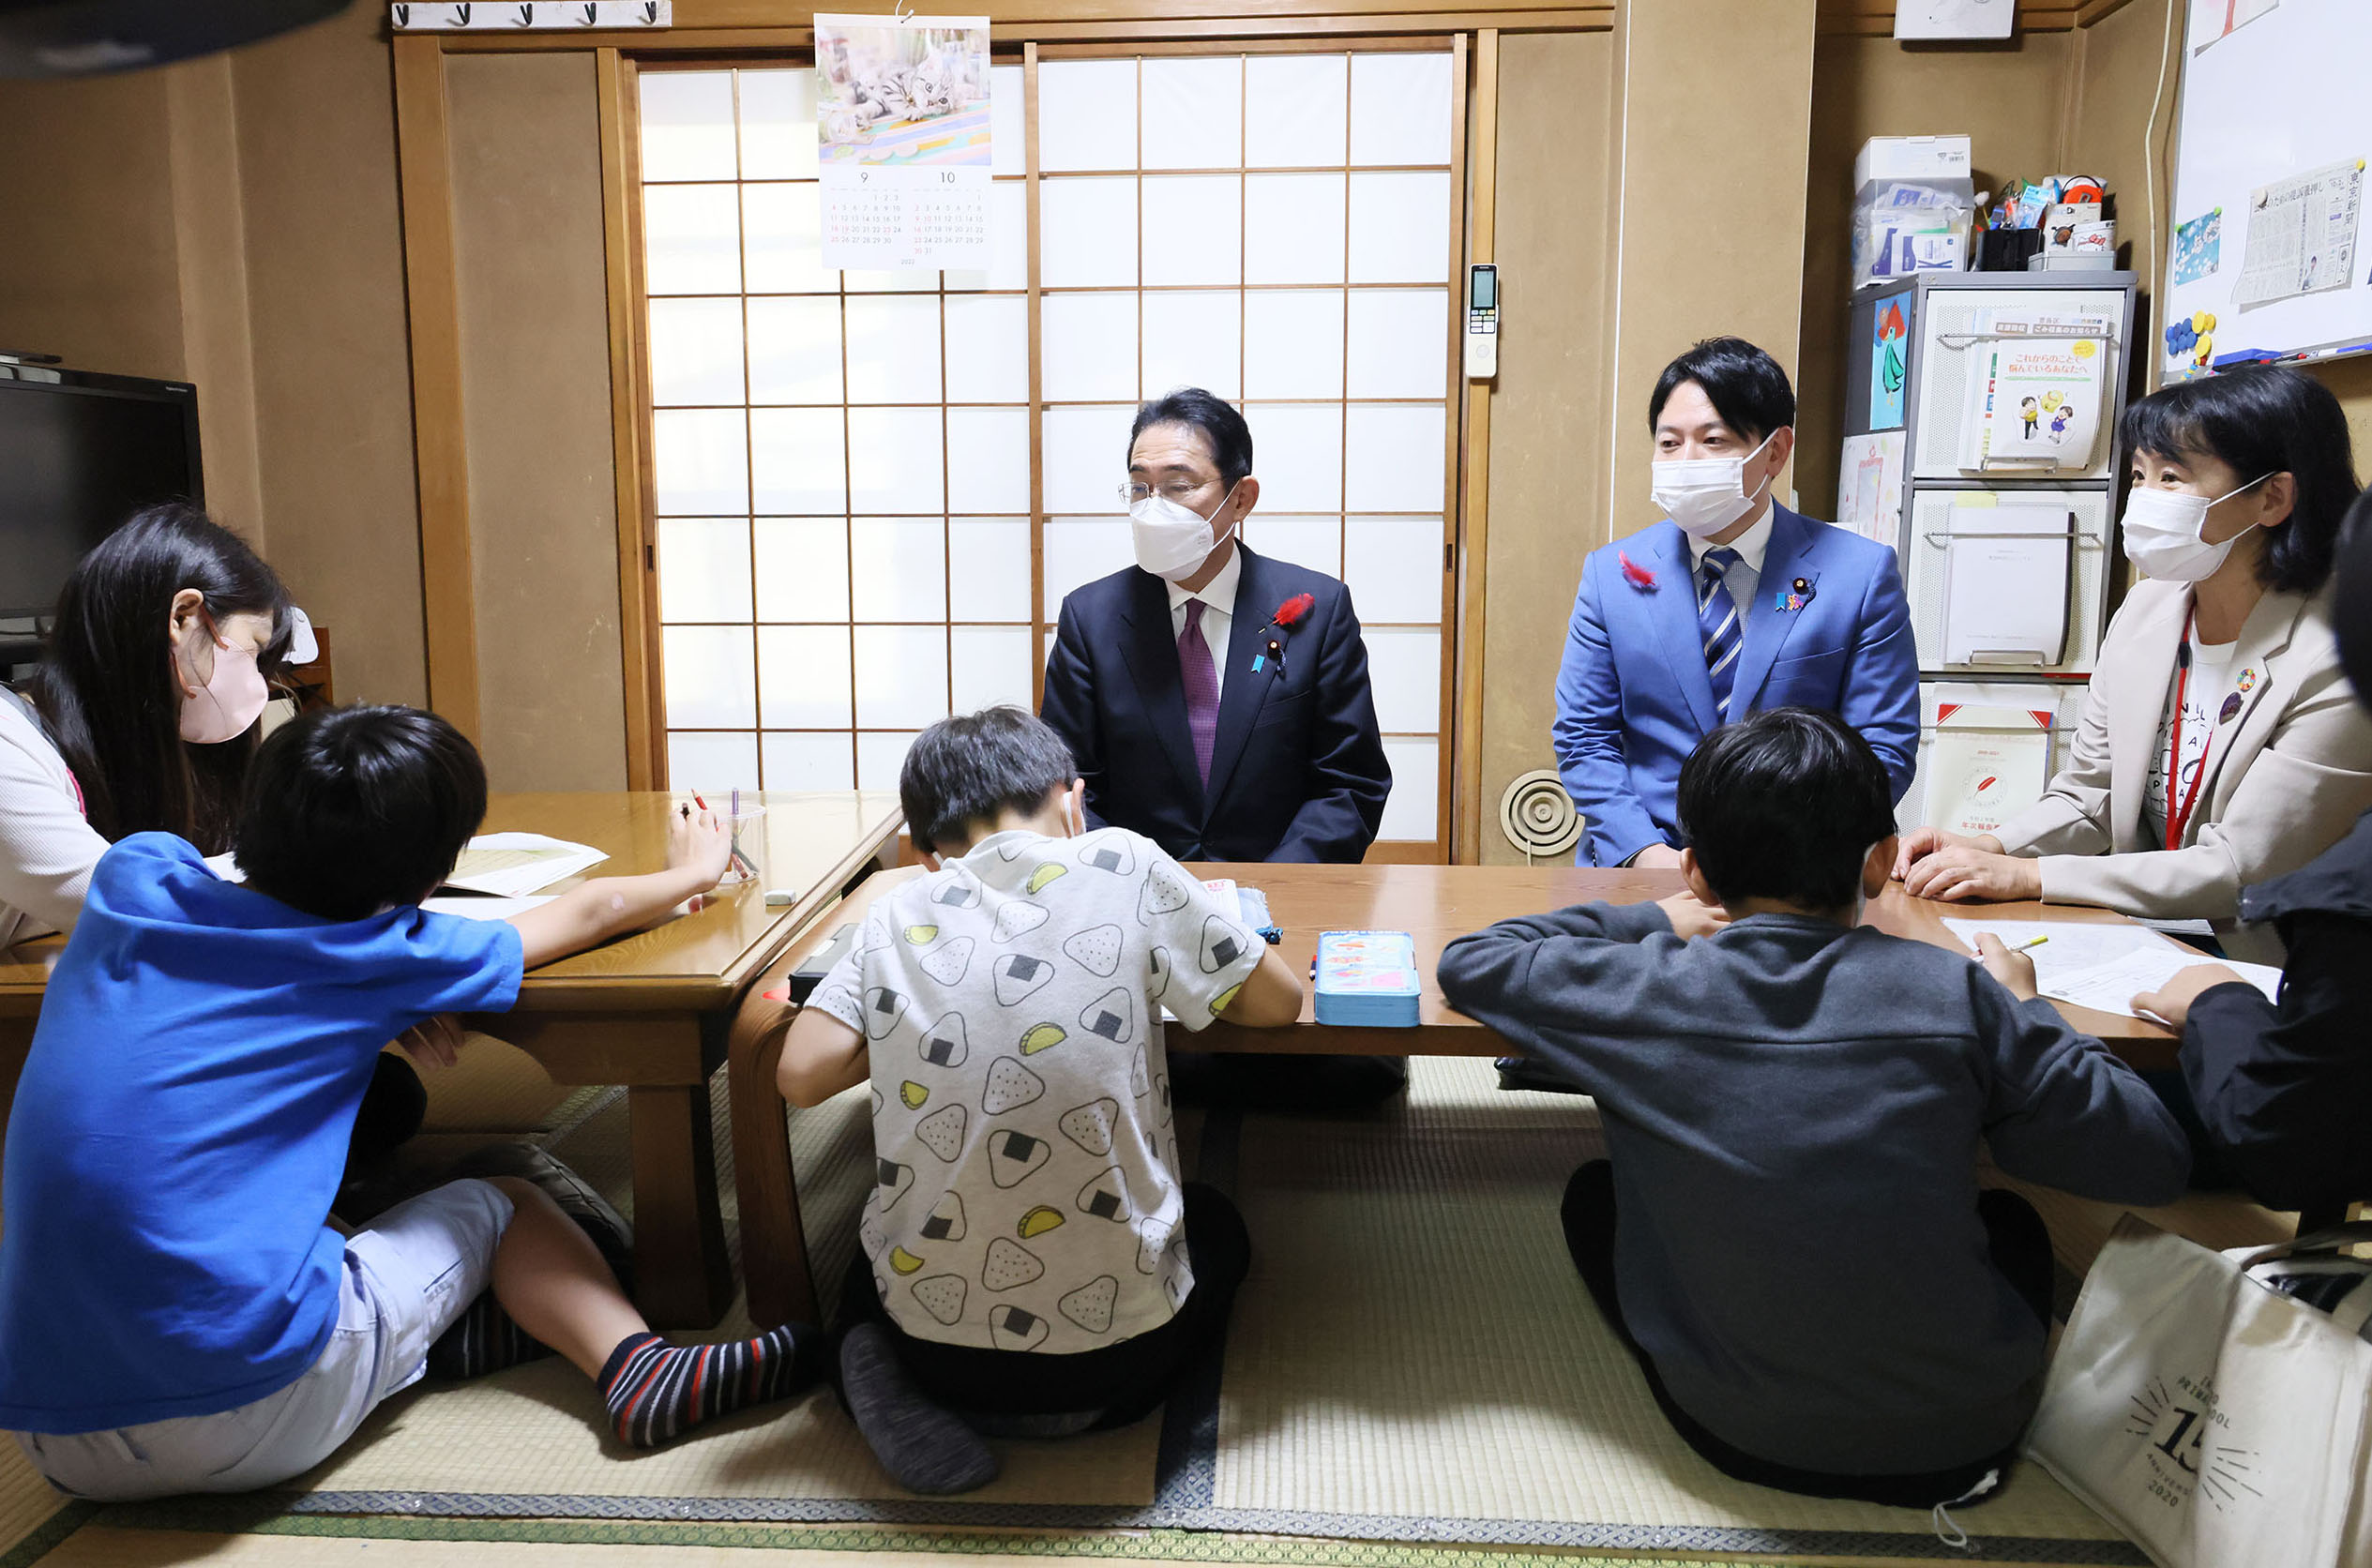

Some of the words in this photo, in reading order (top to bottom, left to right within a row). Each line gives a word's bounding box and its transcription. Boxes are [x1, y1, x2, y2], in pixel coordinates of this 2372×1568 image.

[861, 172, 869, 183] 9
[941, 172, 956, 183] 10
[2148, 1479, 2179, 1508] 2020
